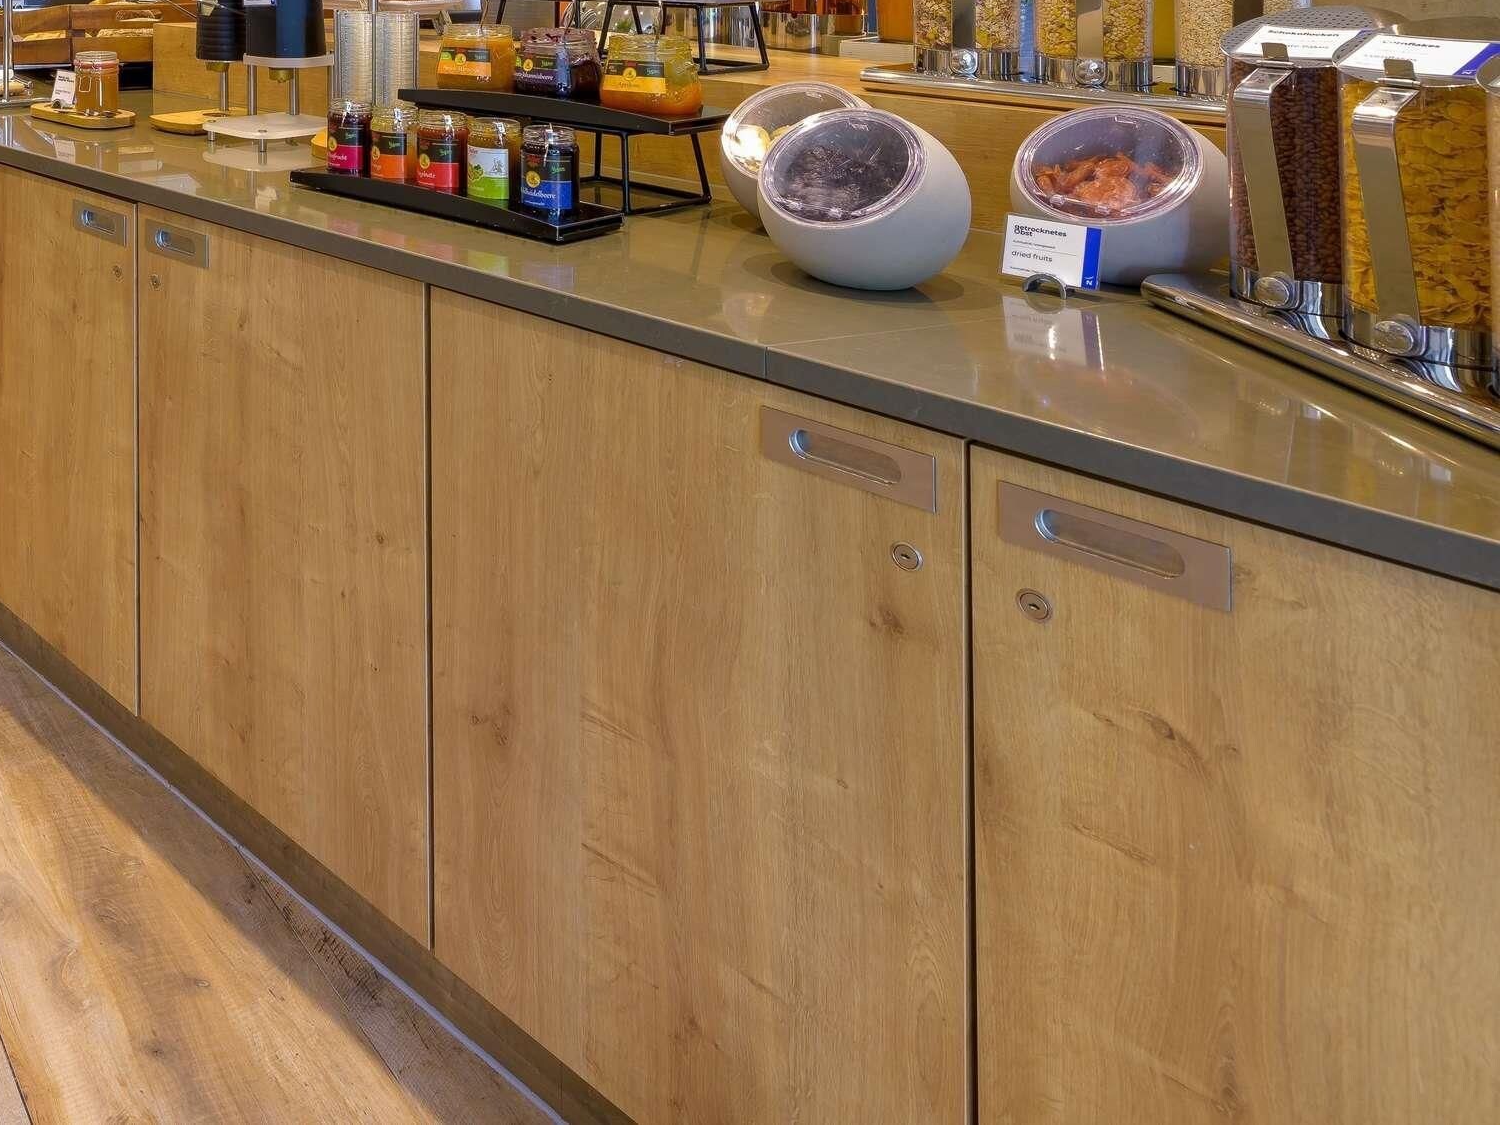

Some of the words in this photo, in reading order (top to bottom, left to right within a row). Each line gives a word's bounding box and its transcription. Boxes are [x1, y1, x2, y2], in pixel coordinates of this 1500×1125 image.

[1013, 229, 1033, 237] Obst
[1014, 224, 1067, 237] getrocknetes
[1011, 250, 1031, 259] dried
[1032, 253, 1053, 262] fruits
